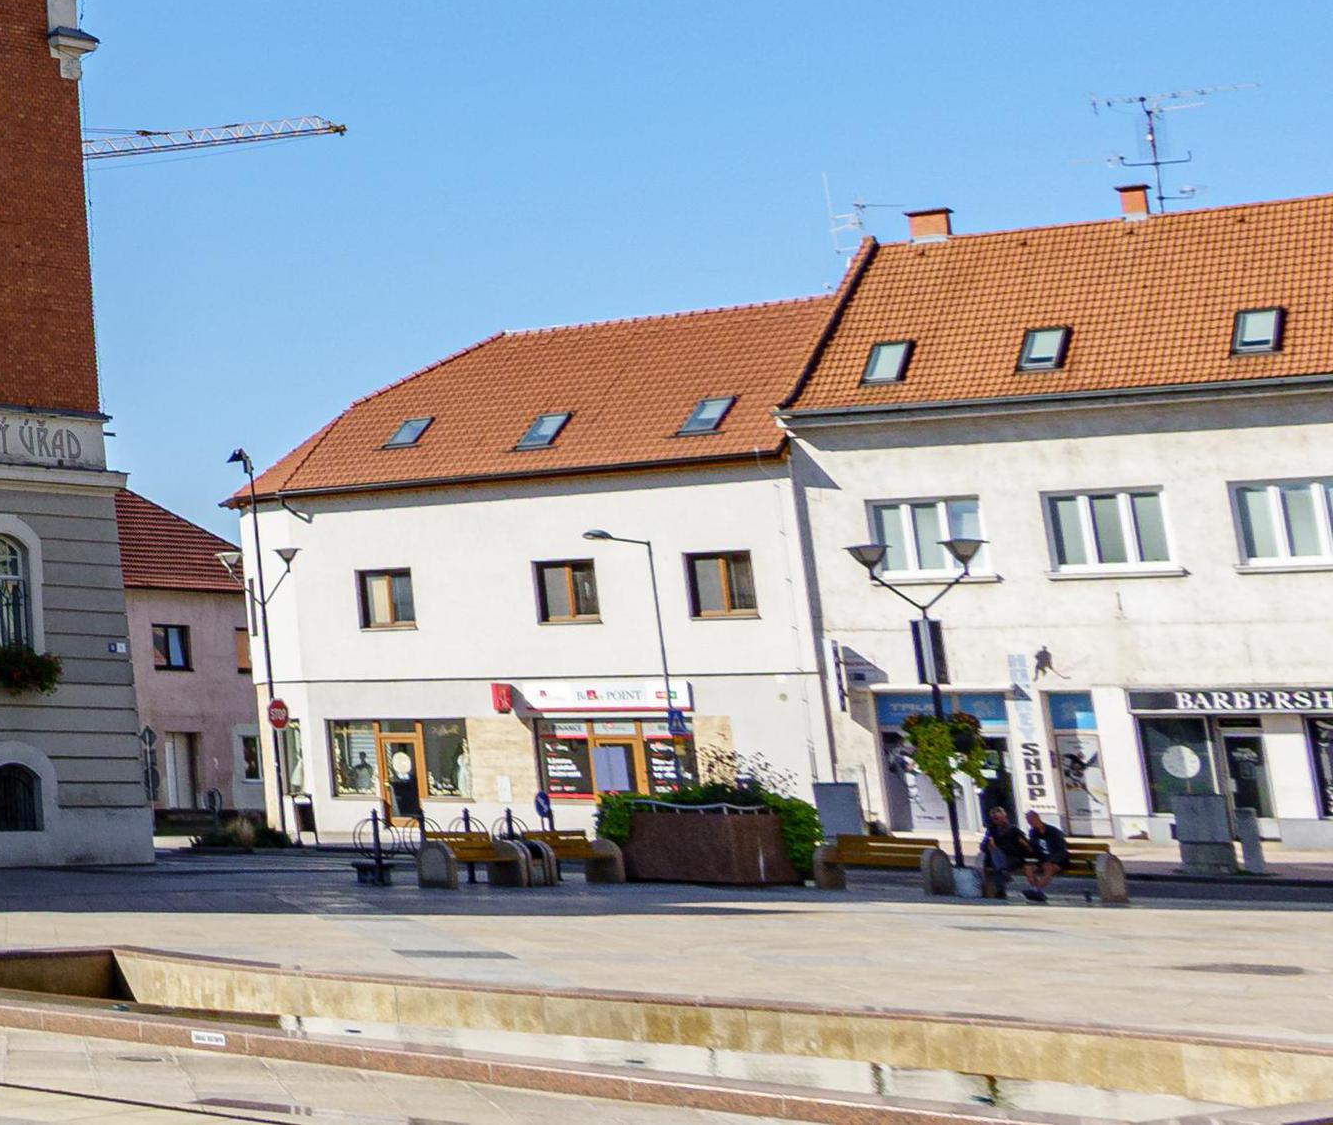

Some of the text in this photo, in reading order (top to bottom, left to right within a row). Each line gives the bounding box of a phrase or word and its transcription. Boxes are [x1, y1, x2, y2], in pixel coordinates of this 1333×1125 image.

[19, 418, 82, 460] ÚŘAD
[606, 690, 642, 701] POINT
[1174, 690, 1333, 710] BARBERSH
[269, 708, 287, 721] STOP
[1020, 742, 1047, 801] SHOP
